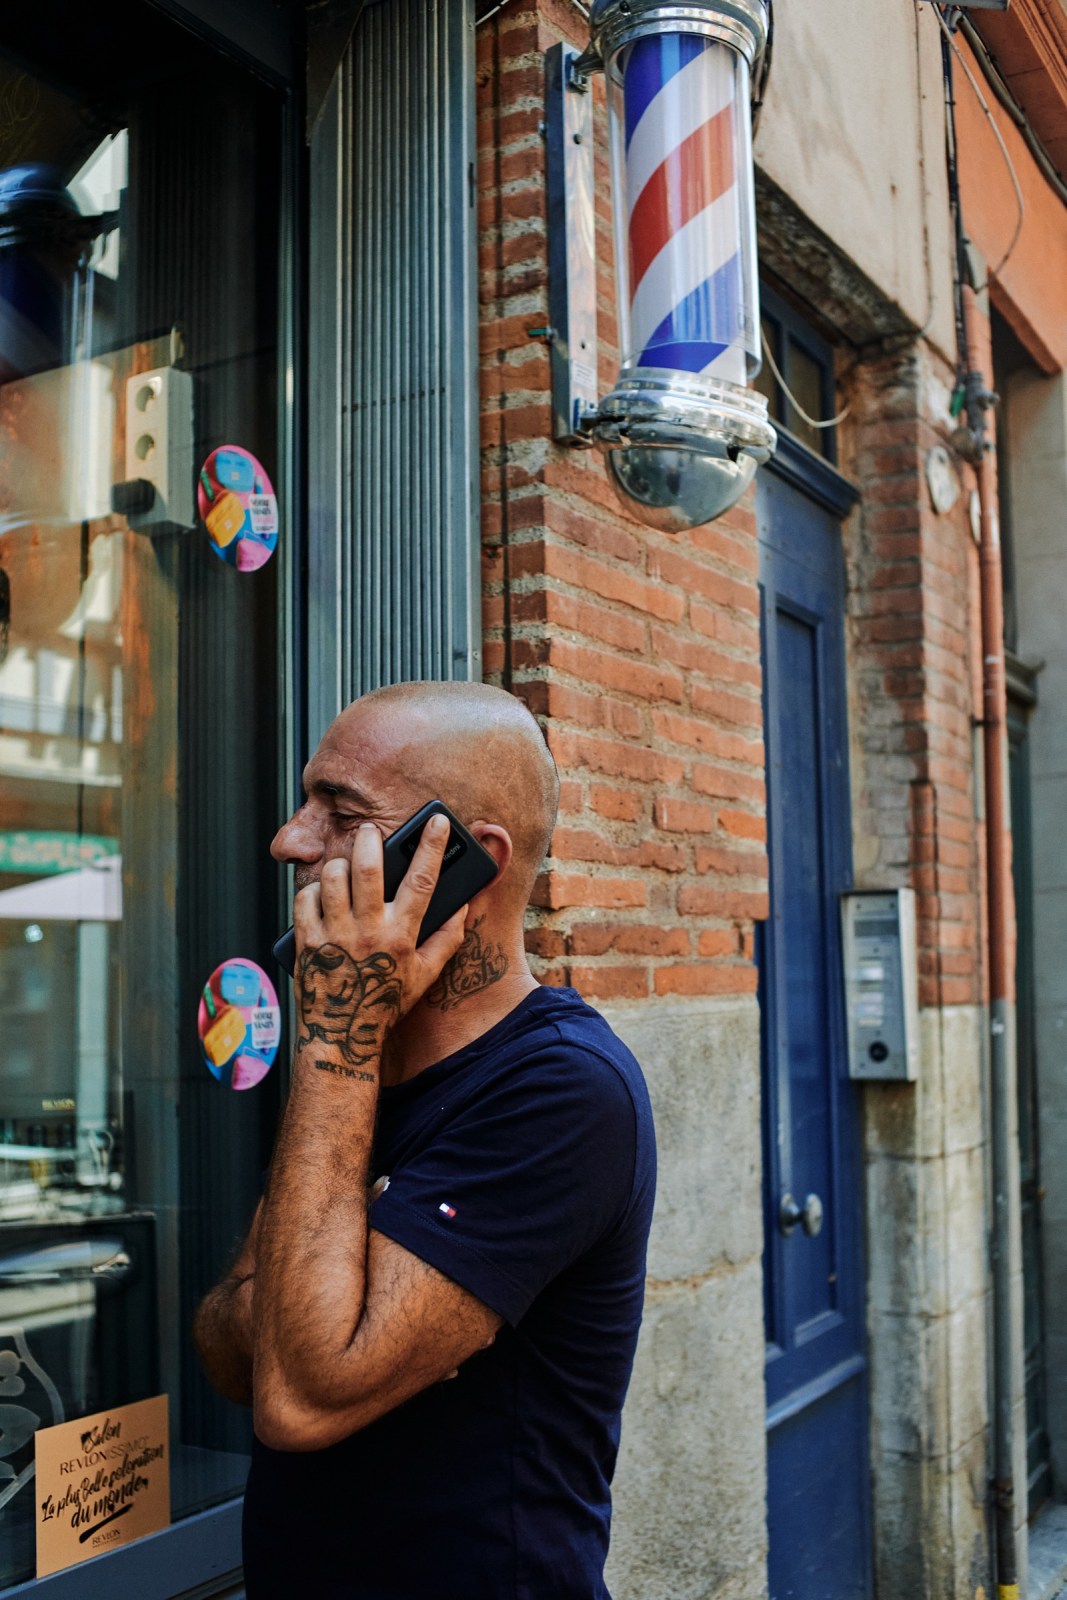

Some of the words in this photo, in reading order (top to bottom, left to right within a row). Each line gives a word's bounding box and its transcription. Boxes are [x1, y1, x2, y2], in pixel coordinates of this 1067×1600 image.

[80, 1418, 121, 1453] Salon
[42, 1494, 55, 1522] La
[57, 1484, 80, 1518] plus
[109, 1444, 164, 1488] coloration
[71, 1501, 90, 1528] du
[92, 1528, 120, 1545] REVLON
